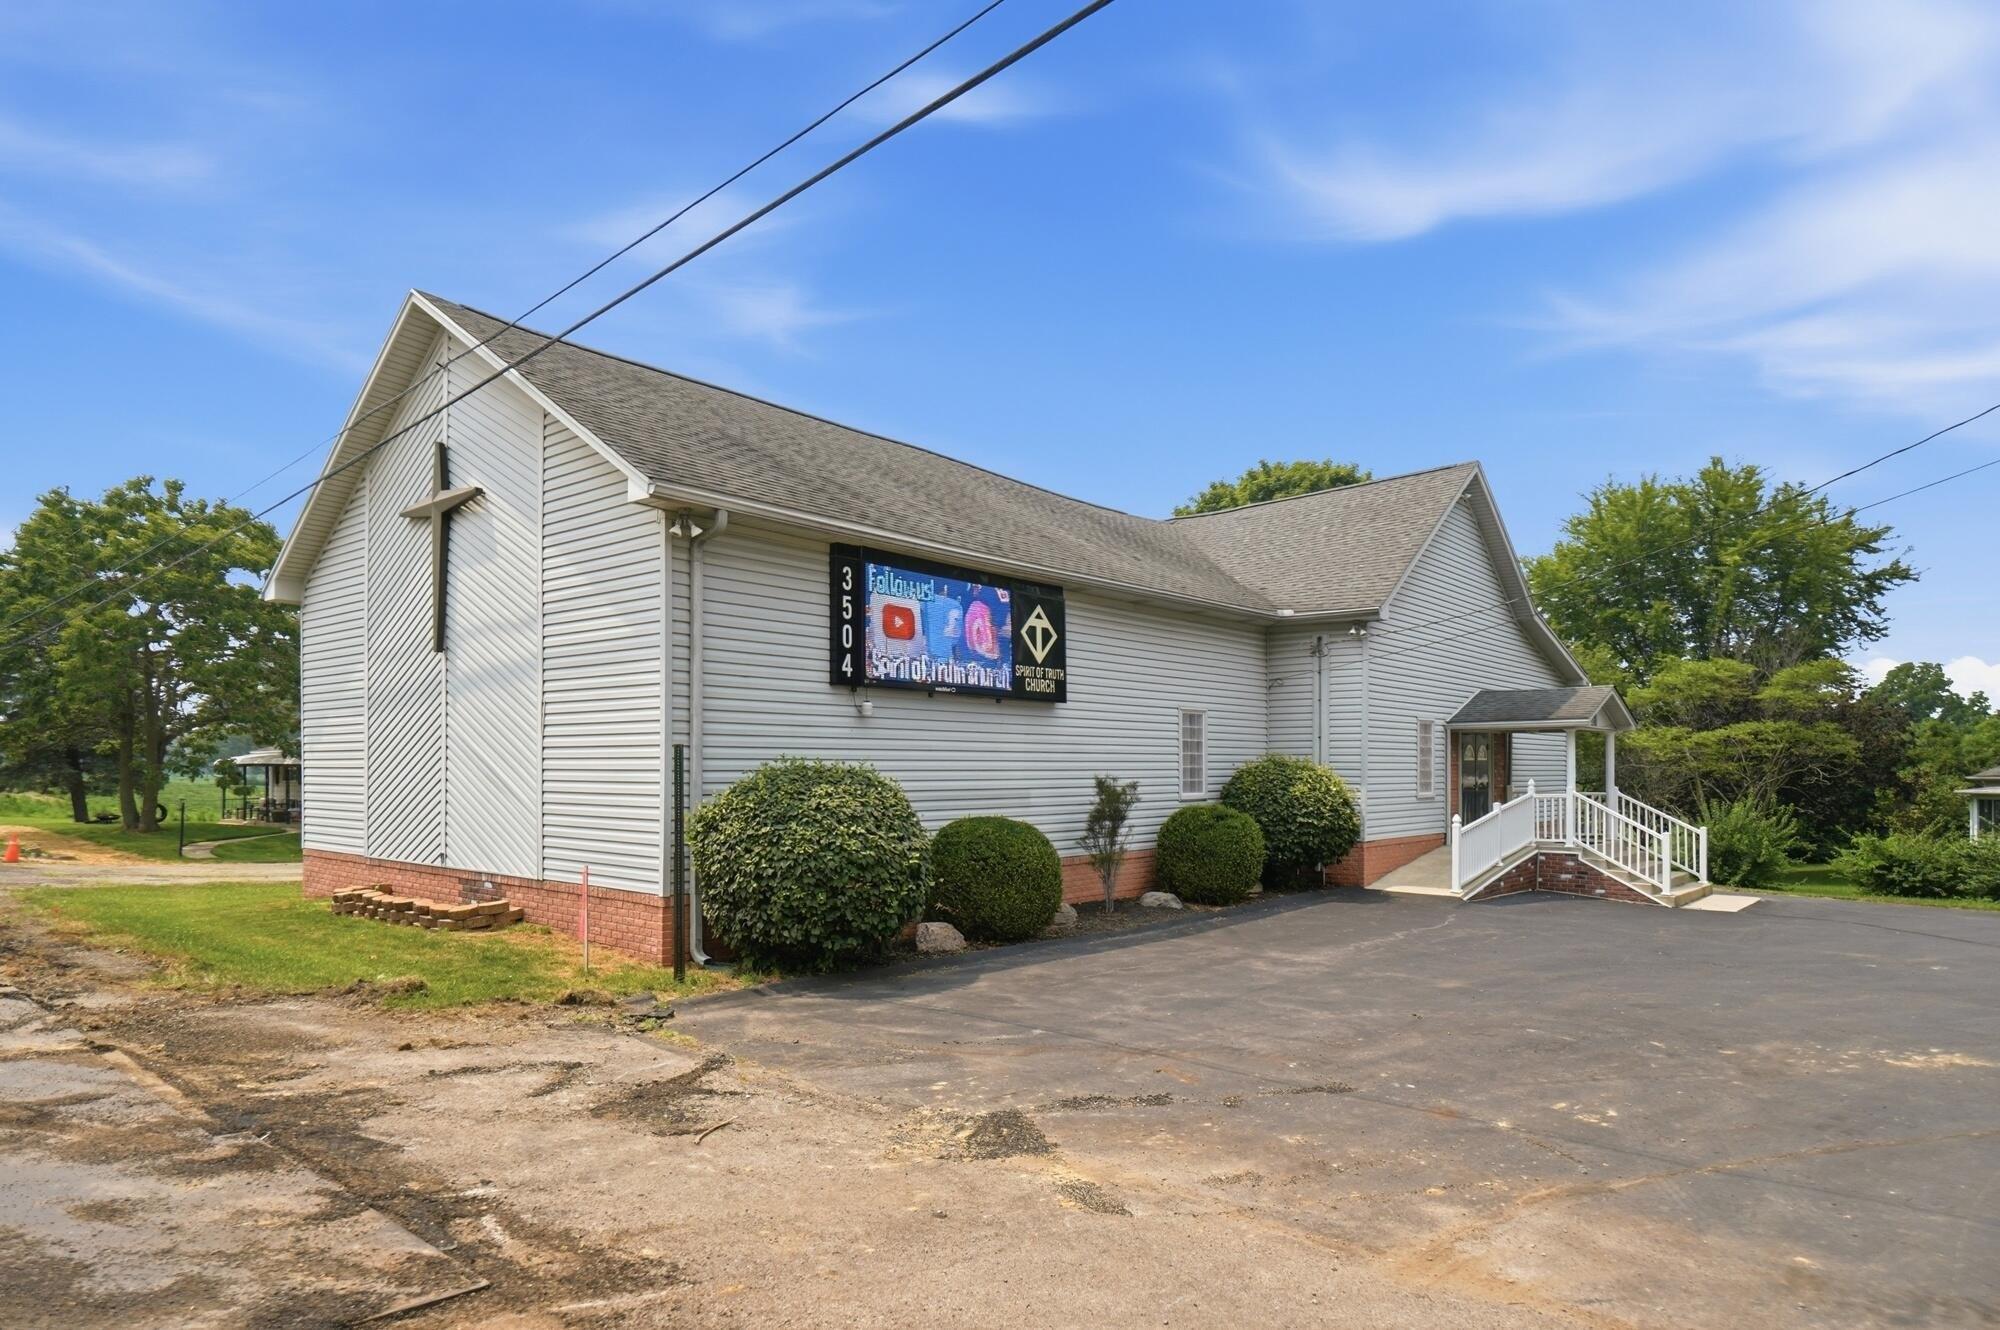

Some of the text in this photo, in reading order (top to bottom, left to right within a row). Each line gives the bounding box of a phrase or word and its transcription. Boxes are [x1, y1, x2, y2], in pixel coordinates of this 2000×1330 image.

[868, 564, 916, 600] Follow
[842, 566, 853, 678] 3504
[1015, 665, 1065, 681] SPIRIT OF TRUTH
[1025, 678, 1055, 693] CHURCH
